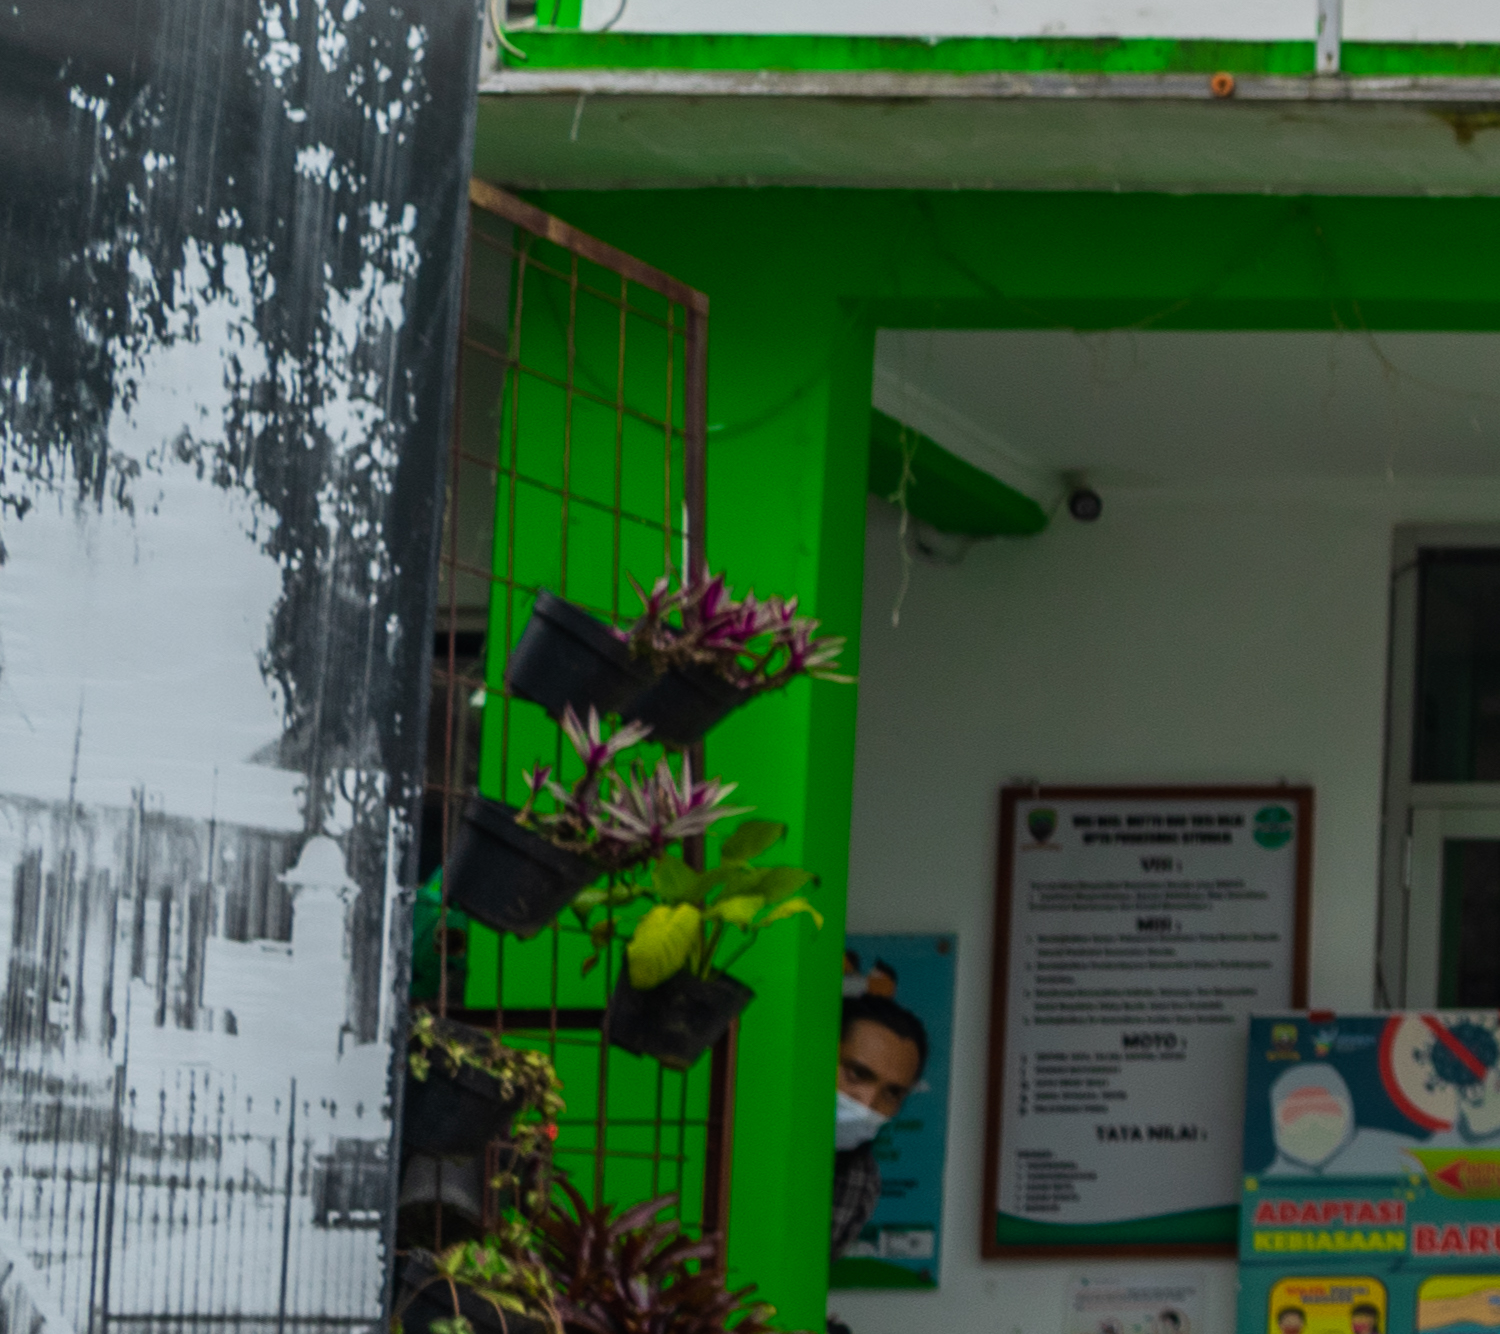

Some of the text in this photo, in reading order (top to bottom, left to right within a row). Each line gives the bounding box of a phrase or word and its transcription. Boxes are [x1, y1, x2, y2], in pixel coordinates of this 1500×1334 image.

[1096, 1126, 1198, 1141] TATA NILAI
[1254, 1200, 1405, 1226] ADAPTASI
[1252, 1231, 1406, 1252] KEBIASAAN
